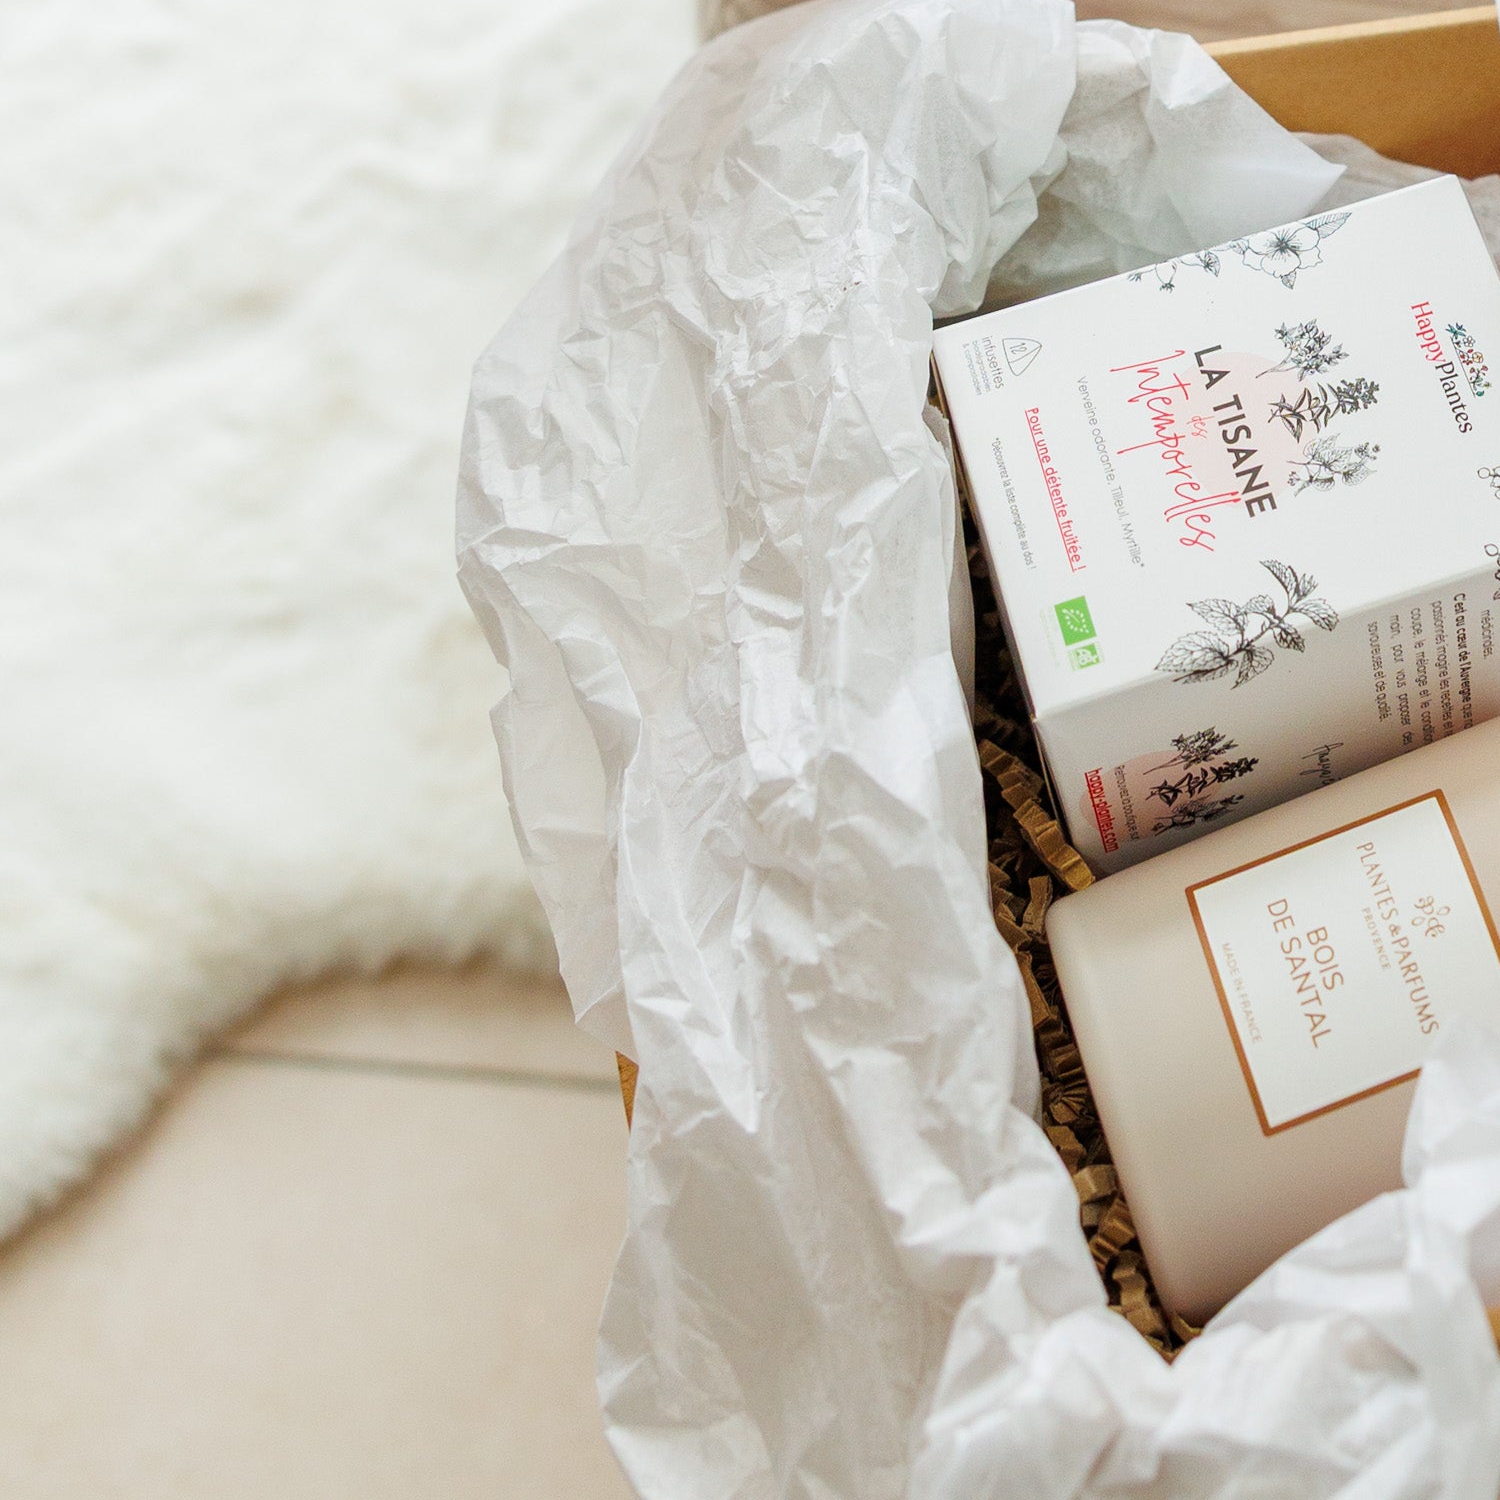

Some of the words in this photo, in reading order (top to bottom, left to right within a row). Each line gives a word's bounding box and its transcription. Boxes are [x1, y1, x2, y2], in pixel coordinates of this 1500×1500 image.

[980, 334, 1007, 390] infusettes
[1009, 341, 1028, 356] 12
[1025, 405, 1047, 437] Pour
[1183, 410, 1217, 442] des
[1194, 345, 1230, 390] LA
[1213, 394, 1277, 517] TISANE
[1035, 437, 1055, 464] une
[1075, 375, 1100, 427] Verveine
[1088, 426, 1119, 486] odorante,
[1108, 484, 1132, 521] Tilleul,
[1110, 349, 1241, 551] Intemporelles
[1044, 465, 1072, 518] détente
[1059, 518, 1085, 563] fruitée
[1451, 592, 1466, 615] C'est
[1453, 614, 1464, 627] au
[1456, 649, 1470, 662] de
[1456, 661, 1472, 702] l'Auvergne
[1356, 842, 1398, 920] PLANTES
[1360, 908, 1391, 969] PROVENCE
[1387, 922, 1402, 937] &
[1219, 943, 1239, 975] MADE
[1267, 899, 1294, 932] DE
[1281, 937, 1331, 1048] SANTAL
[1306, 926, 1344, 990] BOIS
[1231, 979, 1245, 991] IN
[1392, 937, 1439, 1034] PARFUMS
[1236, 992, 1263, 1042] FRANCE
